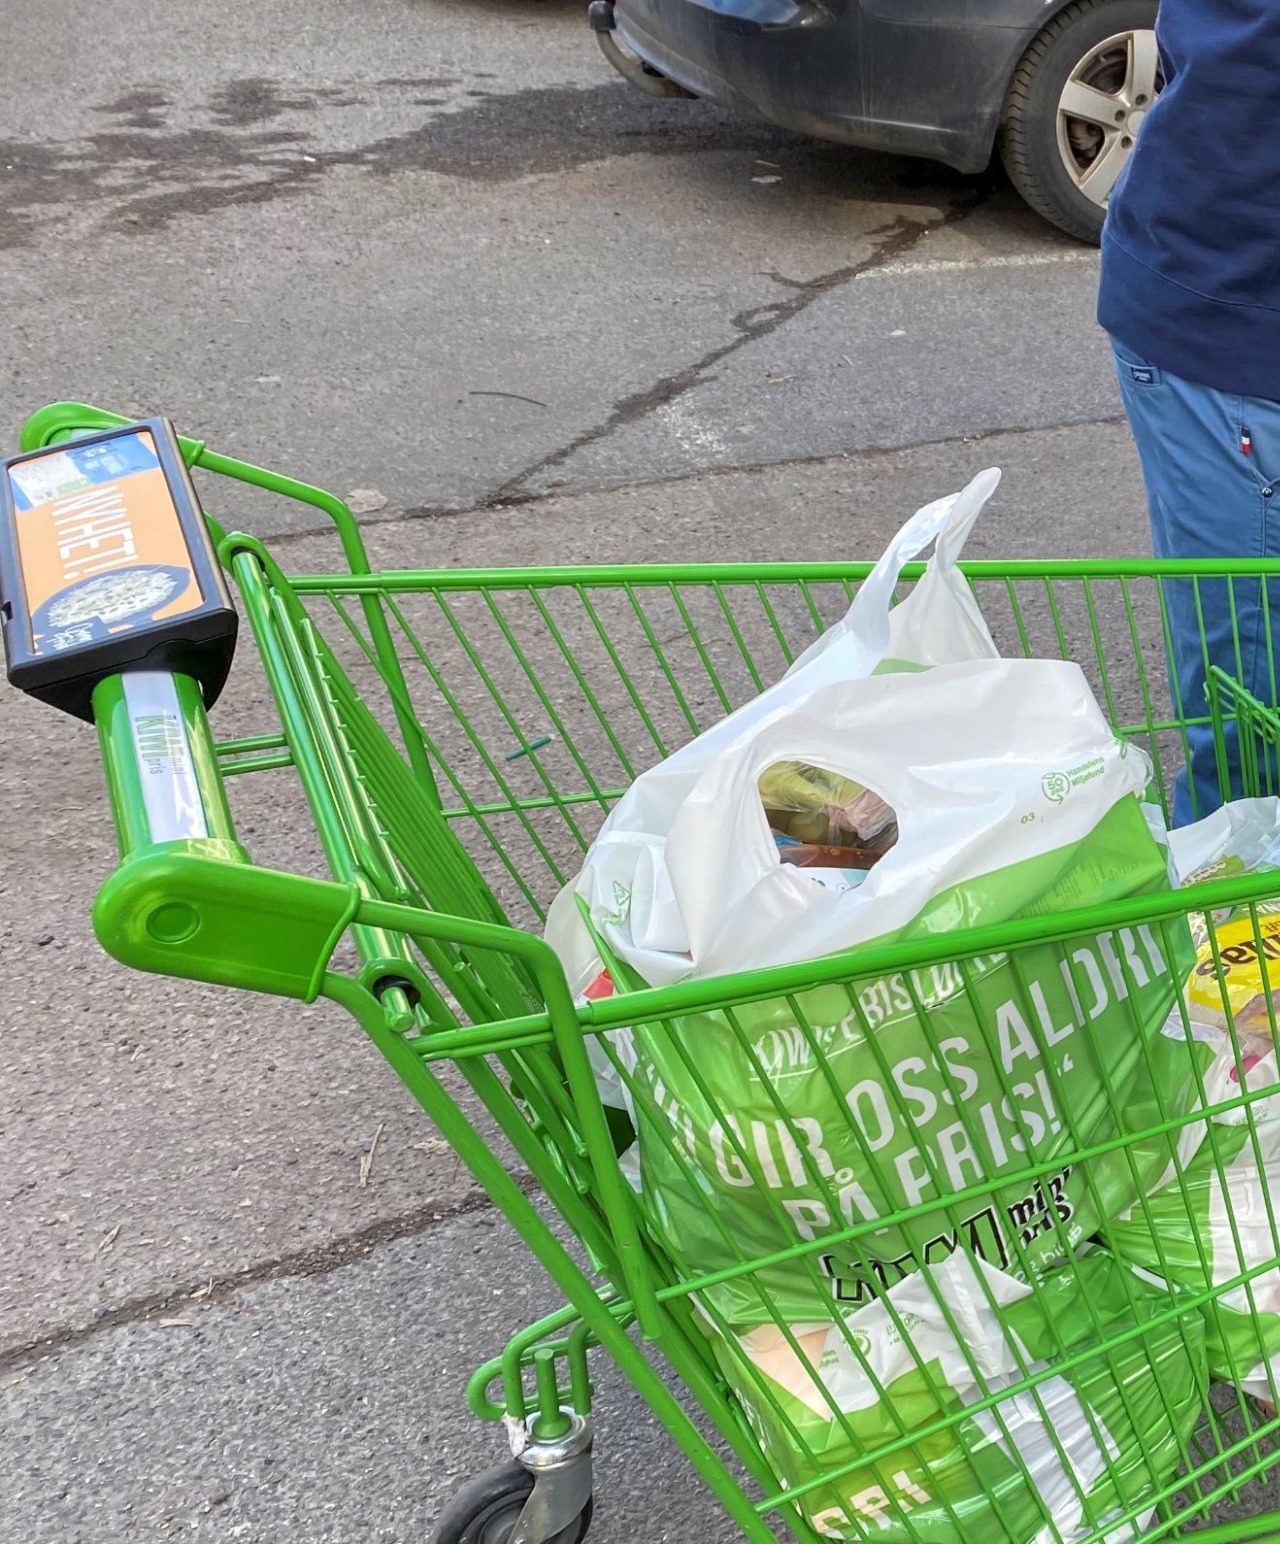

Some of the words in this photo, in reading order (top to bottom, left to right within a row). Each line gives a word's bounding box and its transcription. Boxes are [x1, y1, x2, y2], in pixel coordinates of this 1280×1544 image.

[51, 485, 139, 580] NYHET!
[708, 1112, 835, 1189] GIR
[845, 1036, 979, 1153] OSS
[995, 924, 1168, 1076] ALDRI
[782, 1167, 890, 1241] PÅ
